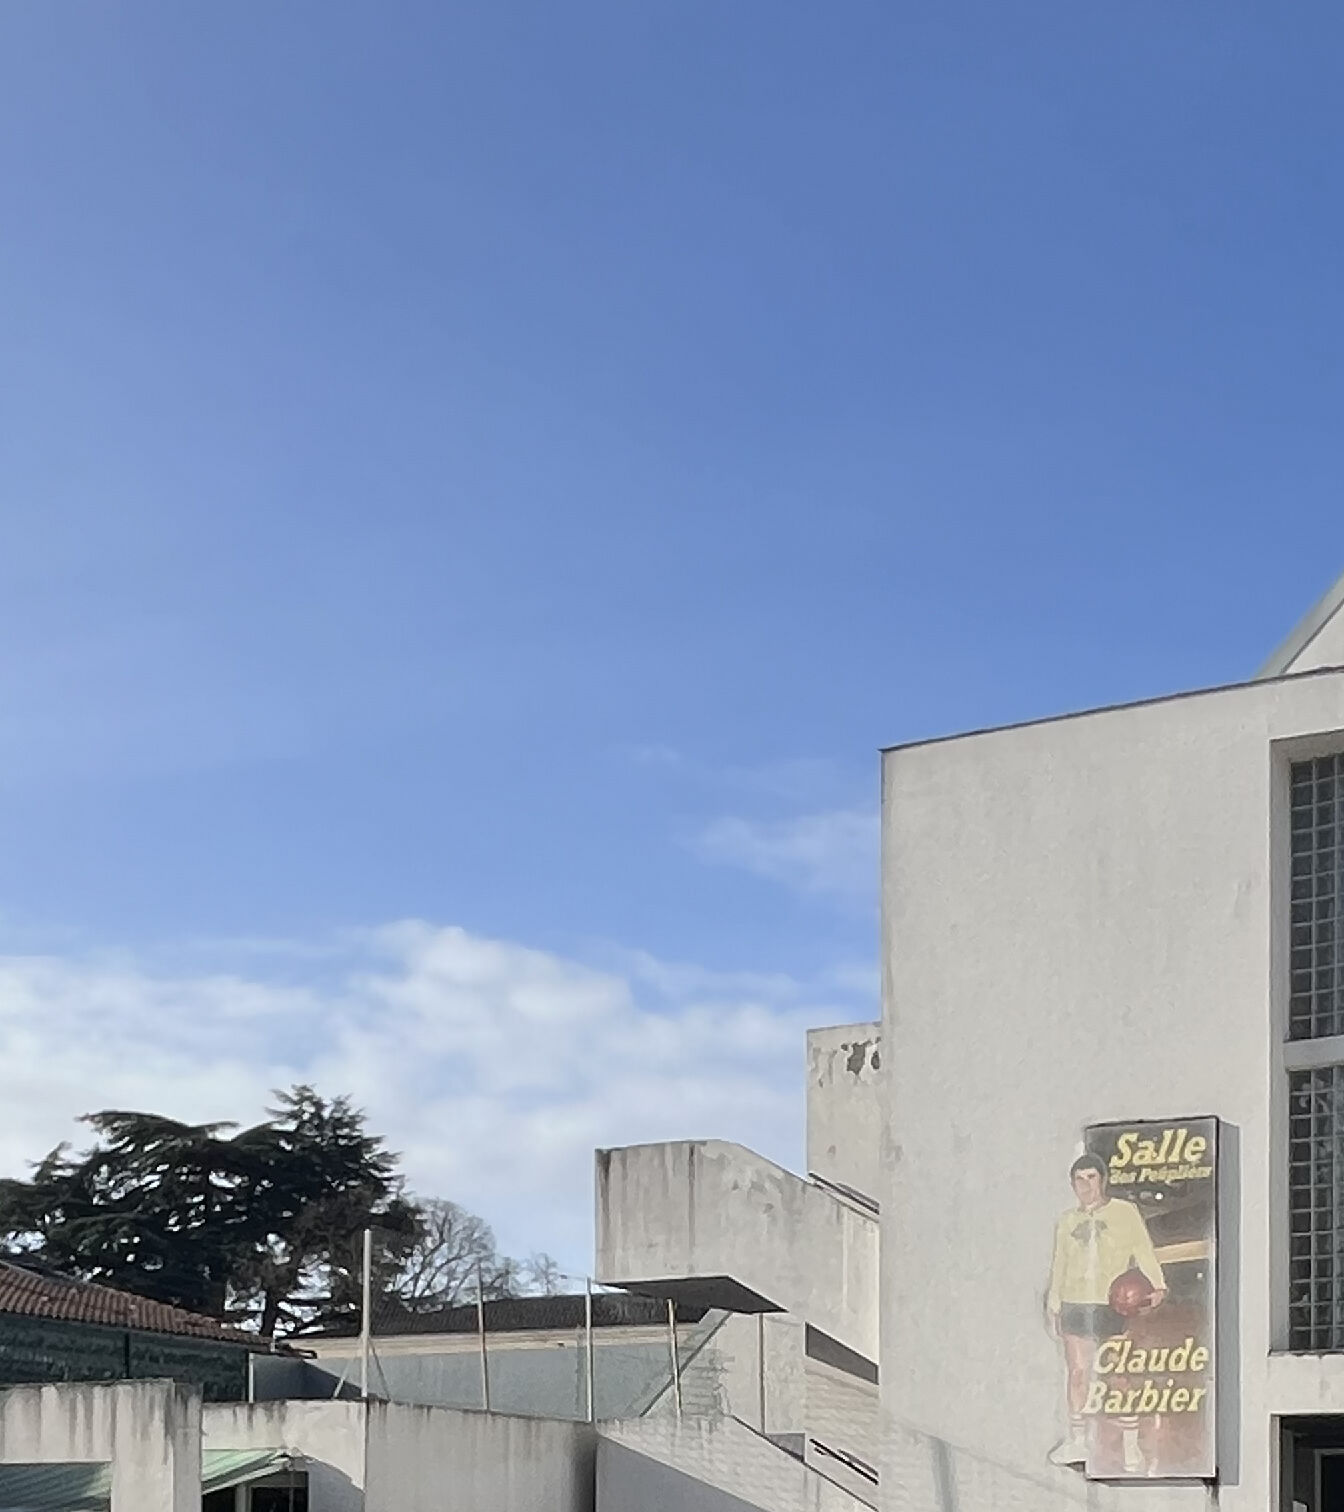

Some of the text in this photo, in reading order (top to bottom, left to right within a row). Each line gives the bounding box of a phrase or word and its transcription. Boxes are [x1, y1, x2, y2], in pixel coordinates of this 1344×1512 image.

[1109, 1128, 1206, 1168] Salle
[1094, 1337, 1209, 1374] Claude
[1080, 1379, 1207, 1414] Barbier
